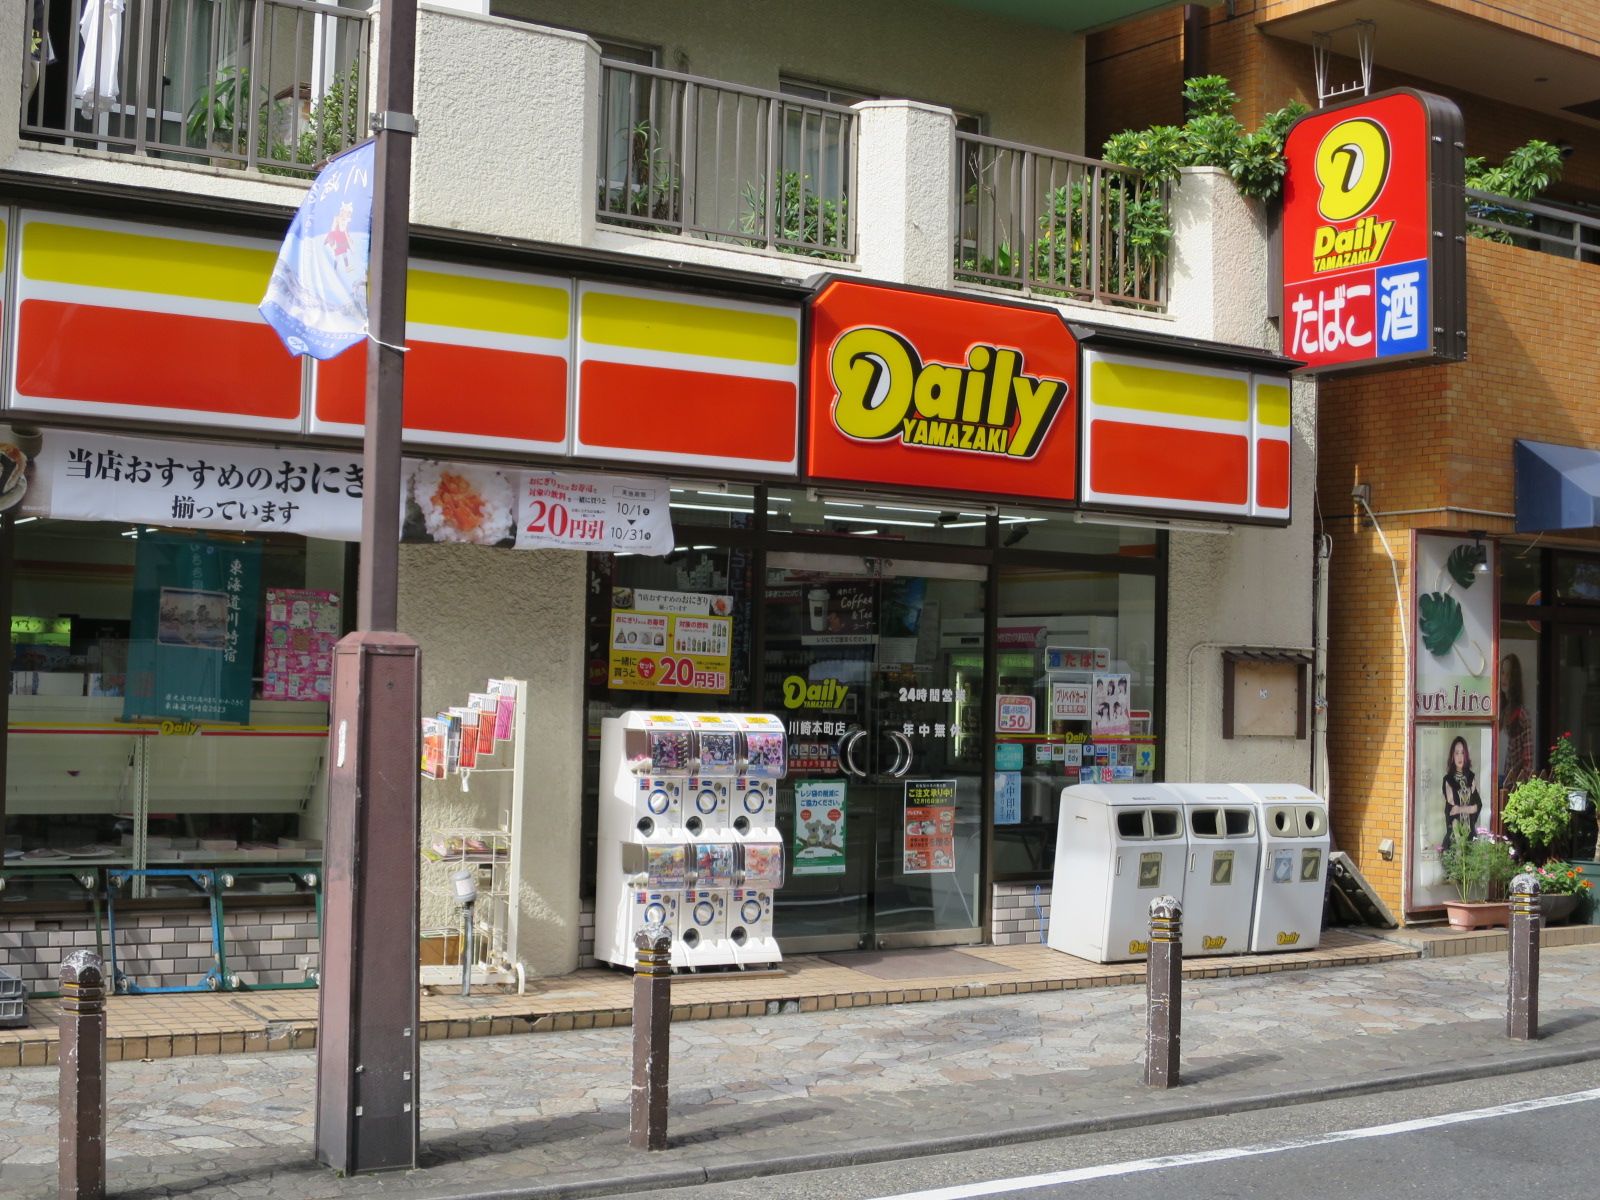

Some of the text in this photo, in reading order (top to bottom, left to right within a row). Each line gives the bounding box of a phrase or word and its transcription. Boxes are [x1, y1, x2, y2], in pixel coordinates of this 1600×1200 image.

[1313, 215, 1396, 266] Daily
[1313, 249, 1371, 273] YAMAZAKI
[1291, 284, 1373, 354] たばこ
[1381, 271, 1420, 342] 酒
[830, 326, 1067, 458] Daily
[903, 417, 1010, 453] YAMAZAKI
[171, 495, 300, 524] 揃っています
[526, 499, 605, 541] 20円引
[223, 558, 244, 663] 東海道川崎宿
[1064, 651, 1106, 668] たばこ
[782, 675, 848, 709] Daily
[899, 687, 967, 703] 24時間営業
[160, 720, 199, 736] Daily
[902, 722, 964, 738] 年中無休
[1202, 935, 1227, 950] Daily
[1277, 931, 1300, 945] Daily
